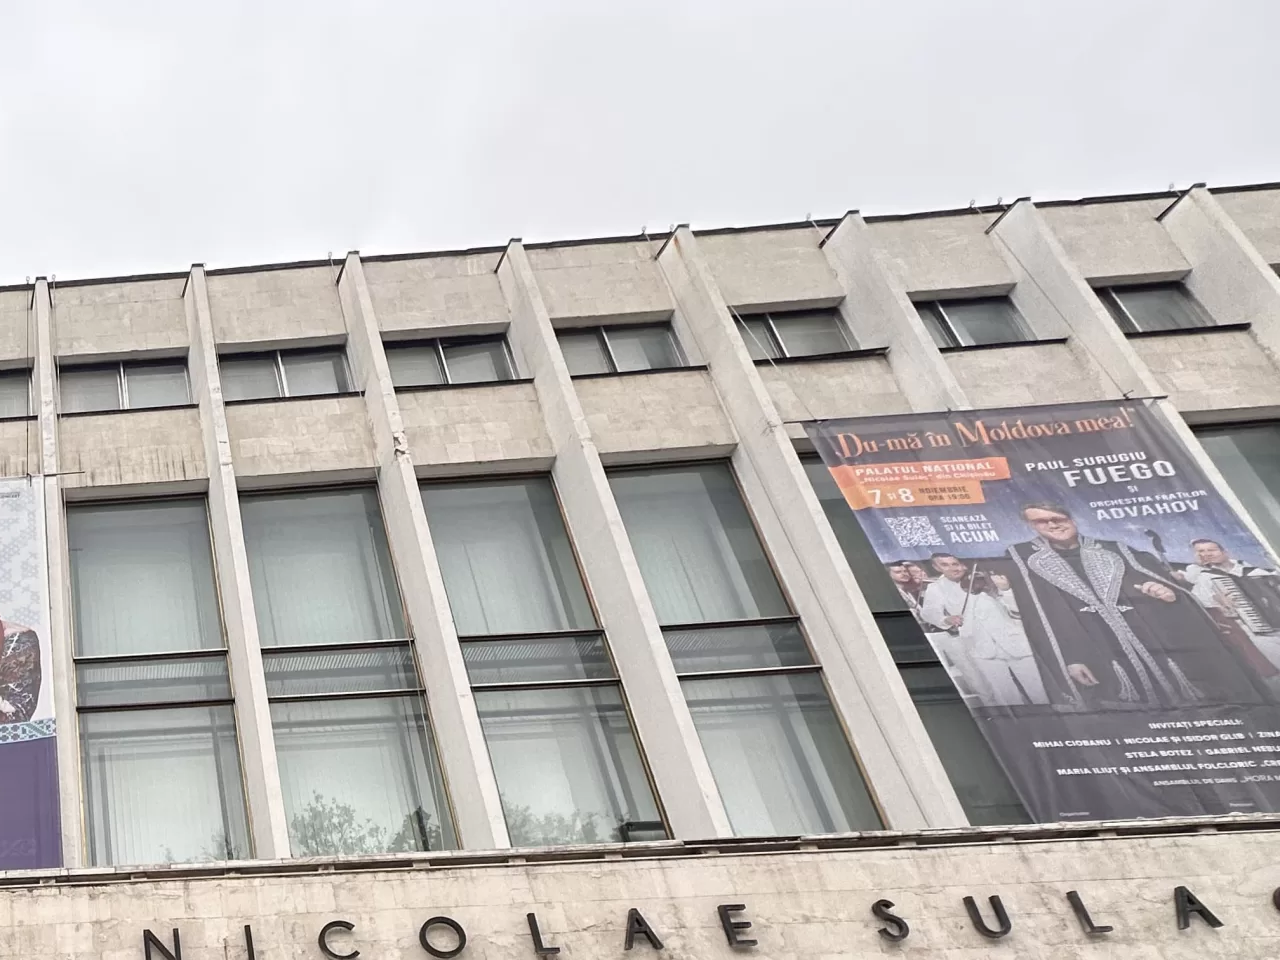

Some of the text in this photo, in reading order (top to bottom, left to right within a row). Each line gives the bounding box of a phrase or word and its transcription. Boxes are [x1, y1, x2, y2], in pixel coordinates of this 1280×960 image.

[926, 433, 951, 450] în
[953, 419, 1071, 449] Moldova
[1024, 451, 1147, 472] PAUL SURUGIU
[855, 466, 919, 476] PALATUL
[1063, 460, 1176, 488] FUEGO
[867, 489, 881, 505] 7
[898, 487, 915, 503] 8
[919, 486, 969, 494] NOIEMBRIE
[1089, 496, 1152, 508] ORCHESTRA
[1096, 500, 1201, 521] ADVAHOV
[967, 522, 993, 531] BILET
[949, 530, 1000, 544] ACUM
[1033, 740, 1064, 748] MIHAI
[1065, 739, 1112, 747] CIOBANU
[1123, 736, 1170, 745] NICOLAE
[1182, 734, 1219, 742] ISIDOR
[1220, 732, 1245, 740] GLIB
[1125, 747, 1251, 759] STELA BOTEZ GABRIEL
[1056, 767, 1092, 776] MARIA
[1132, 763, 1197, 773] ANSAMBLUL
[1198, 760, 1257, 769] FOLCLORIC
[871, 885, 1280, 943] SULA
